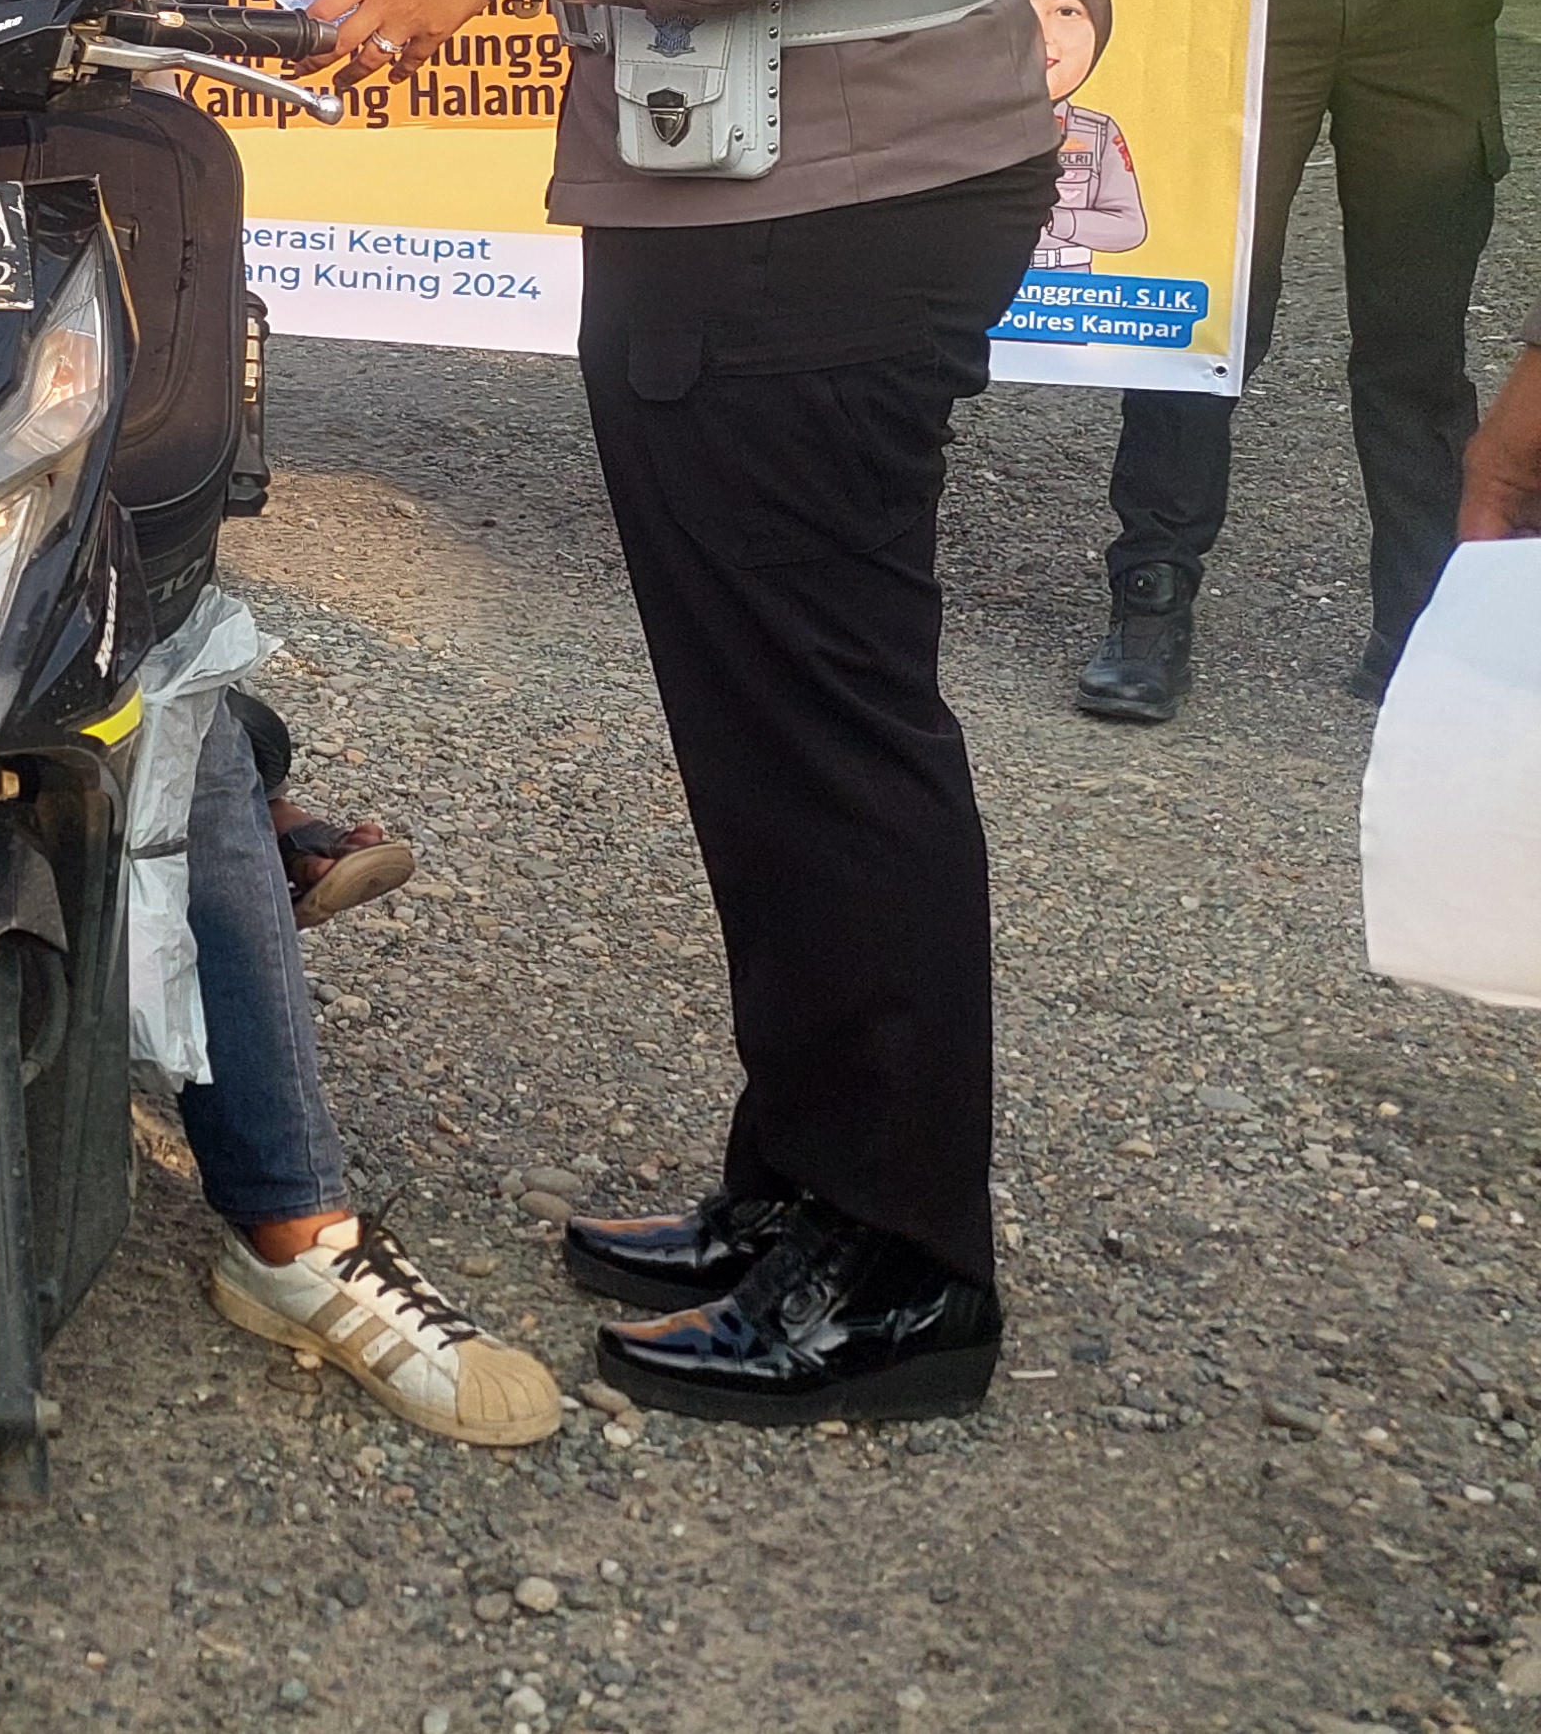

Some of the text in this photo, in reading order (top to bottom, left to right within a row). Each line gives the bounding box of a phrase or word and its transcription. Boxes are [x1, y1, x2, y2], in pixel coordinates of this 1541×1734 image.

[1059, 153, 1088, 166] OLRI
[348, 228, 492, 264] Ketupat
[313, 262, 441, 300] Kuning
[451, 271, 542, 301] 2024
[1135, 288, 1198, 310] S.I.K.
[998, 311, 1183, 341] Polres Kampar
